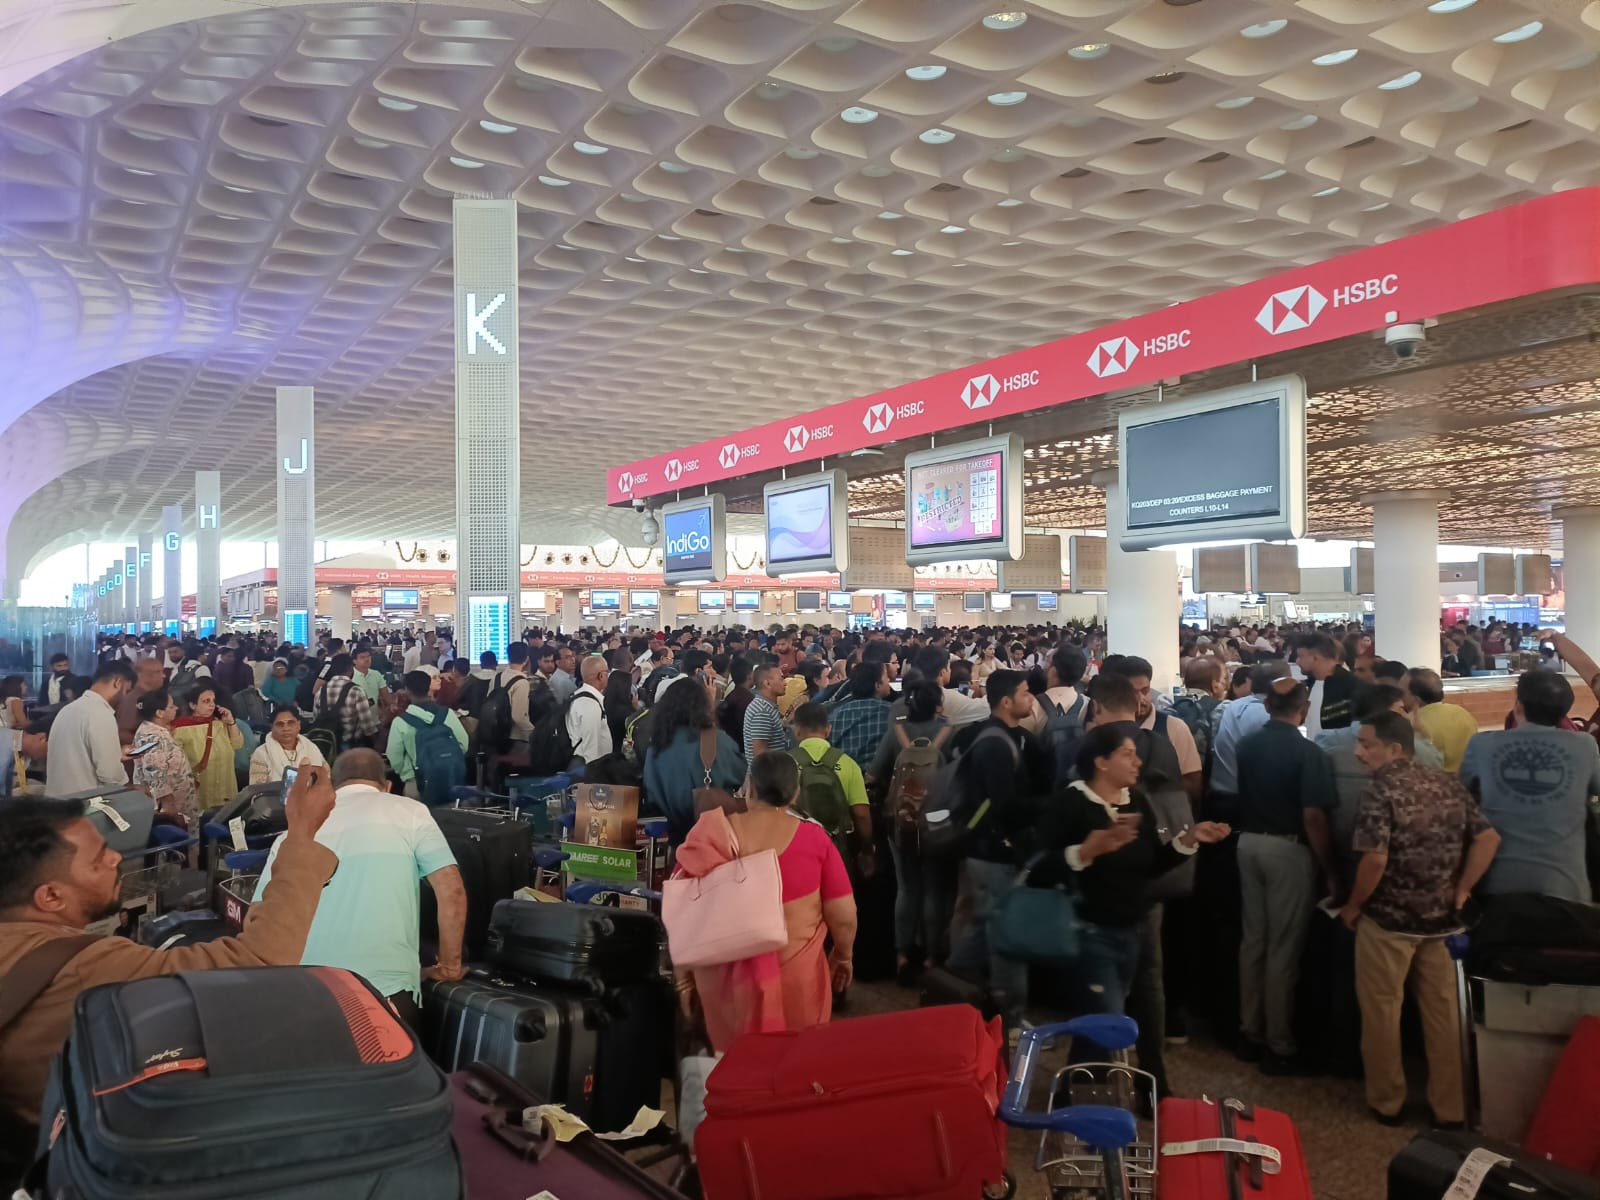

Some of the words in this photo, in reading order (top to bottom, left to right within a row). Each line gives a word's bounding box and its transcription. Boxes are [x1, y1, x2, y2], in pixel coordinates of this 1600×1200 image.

[1333, 274, 1398, 308] HSBC
[466, 293, 506, 355] K
[1143, 329, 1191, 357] HSBC
[1003, 370, 1039, 393] HSBC
[896, 400, 925, 420] HSBC
[811, 424, 834, 441] HSBC
[283, 439, 307, 474] J
[741, 443, 760, 458] HSBC
[684, 459, 700, 472] HSBC
[968, 458, 993, 470] TAKEOFF
[634, 472, 649, 484] HSBC
[1206, 489, 1239, 500] BAGGAGE
[1240, 485, 1273, 496] PAYMENT
[200, 504, 217, 529] H
[1169, 505, 1204, 516] COUNTERS
[165, 531, 179, 551] G
[666, 531, 710, 554] IndiGo
[140, 552, 151, 569] F
[126, 563, 136, 577] E
[106, 580, 114, 591] C
[602, 855, 632, 868] SOLAR
